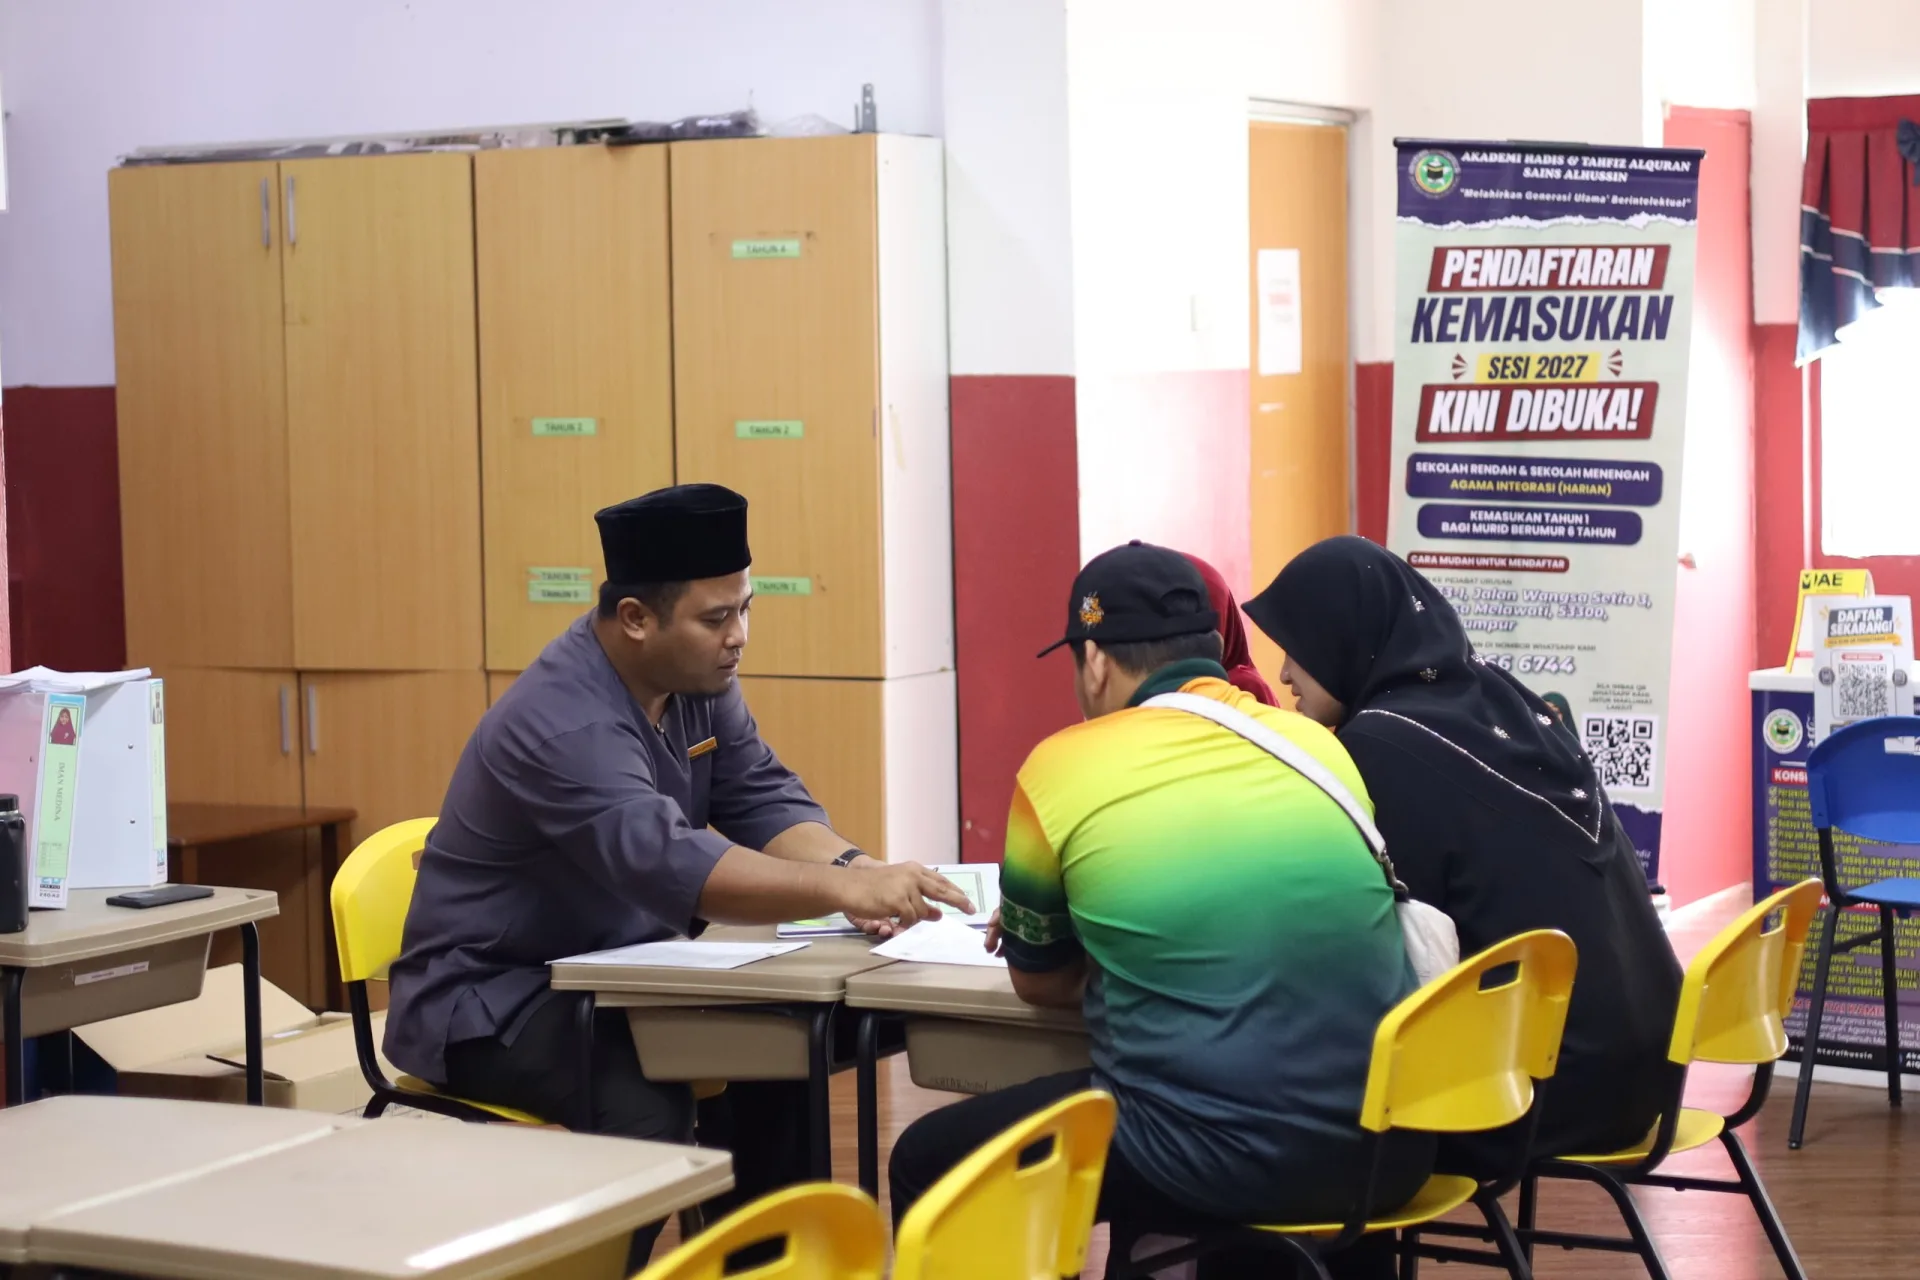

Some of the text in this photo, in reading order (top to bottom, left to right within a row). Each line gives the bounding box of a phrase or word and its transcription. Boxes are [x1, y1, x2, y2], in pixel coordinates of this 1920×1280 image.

[1461, 152, 1691, 172] AKADEMI HADIS & TAHFIZ ALQURAN
[1523, 167, 1628, 182] SAINS ALHUSSIN
[1525, 191, 1571, 202] Generasi
[1441, 248, 1655, 288] PENDAFTARAN
[1411, 295, 1674, 343] KEMASUKAN
[1488, 355, 1588, 380] SESI 2027
[1428, 387, 1644, 433] KINI DIBUKA!
[1416, 461, 1650, 481] SEKOLAH RENDAH & SEKOLAH MENENGAH
[1450, 479, 1612, 498] AGAMA INTEGRASI (HARIAN)
[1470, 510, 1590, 525] KEMASUKAN TAHUN 1
[1441, 521, 1616, 539] BAGI MURID BERUMUR 6 TAHUN
[1410, 555, 1565, 569] CARA MUDAH UNTUK MENDAFTAR
[1472, 588, 1518, 601] Jalan
[1523, 589, 1588, 605] Wangsa
[1591, 590, 1634, 605] Setia
[1474, 603, 1553, 620] Melawati,
[1557, 604, 1608, 622] 53300,
[1838, 608, 1884, 623] DAFTAR
[1462, 619, 1517, 633] umpur
[1830, 620, 1893, 636] SEKARANG!
[1518, 654, 1575, 674] 6744
